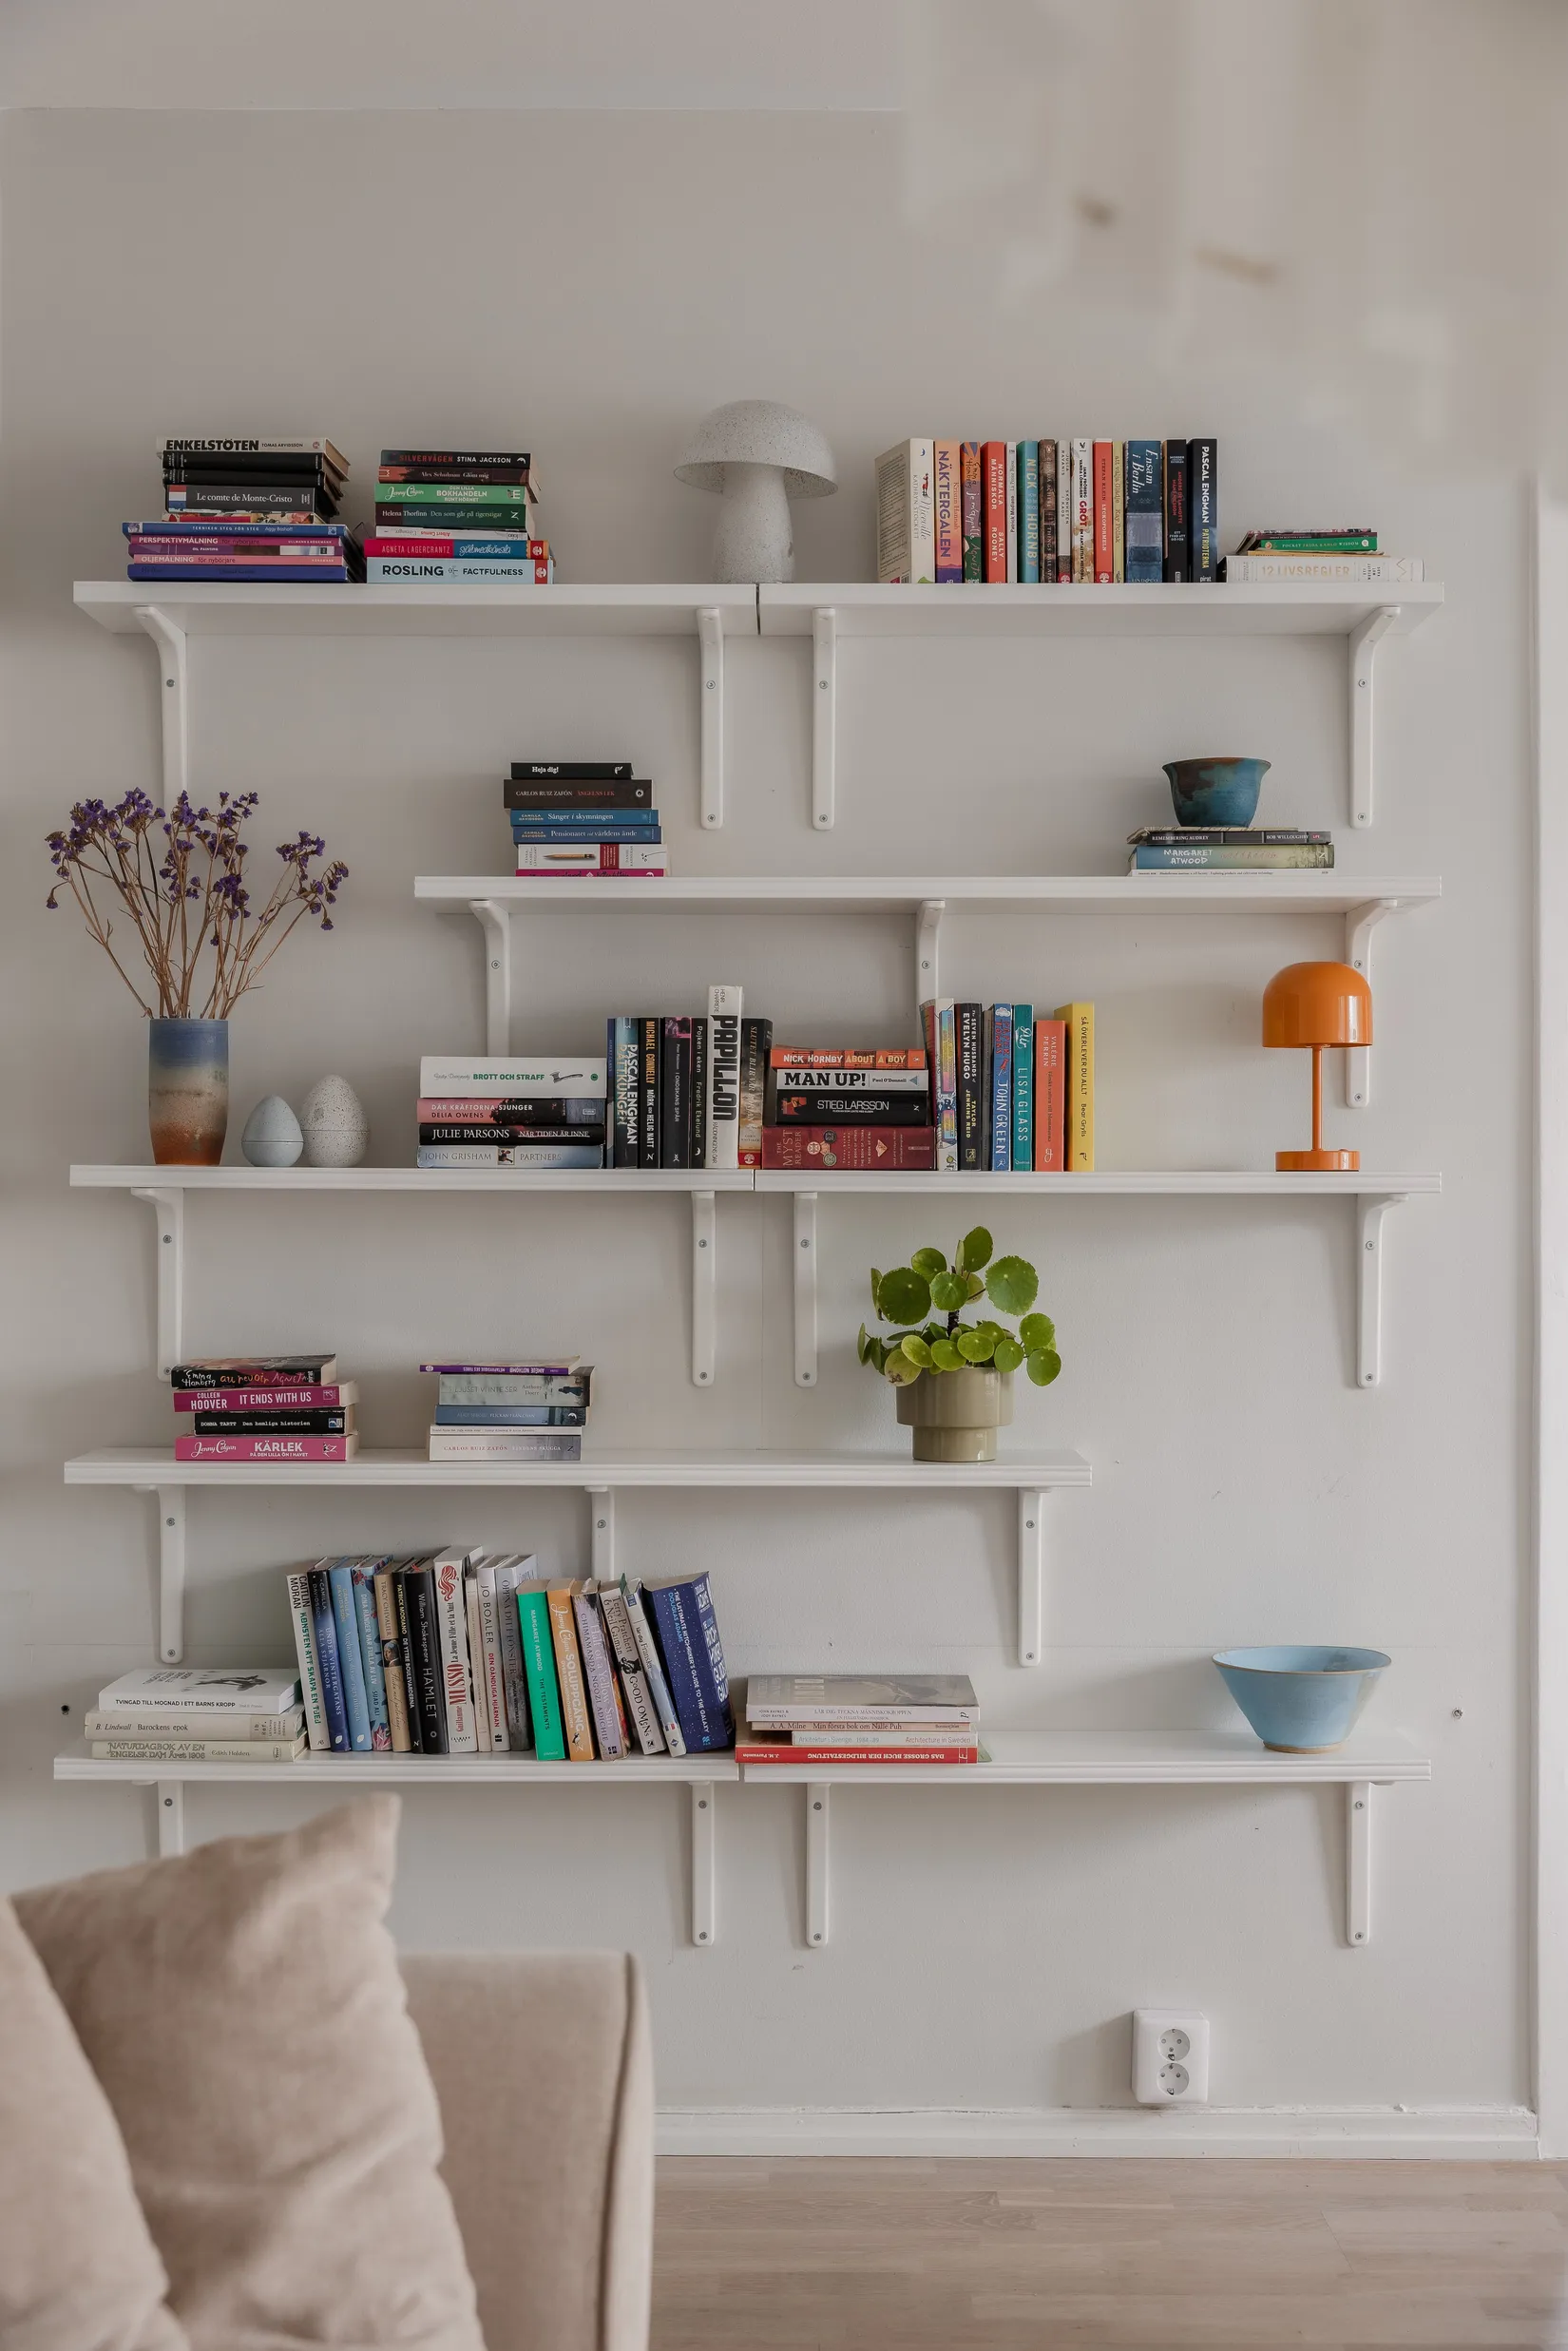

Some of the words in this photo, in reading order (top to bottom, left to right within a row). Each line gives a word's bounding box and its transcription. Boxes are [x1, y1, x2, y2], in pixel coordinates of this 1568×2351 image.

[166, 439, 258, 450] ENKELSTÖTEN
[1027, 459, 1036, 488] NICK
[1132, 462, 1144, 493] Berlin
[1146, 449, 1158, 484] Ensam
[939, 451, 951, 557] NÄKTERGALEN
[1080, 501, 1092, 526] GRÖT
[1027, 514, 1037, 565] HORNBY
[382, 565, 443, 576] ROSLING
[1262, 566, 1272, 575] 12
[1277, 566, 1349, 576] LIVSREGLER
[646, 1021, 655, 1050] MICHAEL
[1081, 1017, 1087, 1025] SÅ
[627, 1044, 638, 1090] PASCAL
[646, 1054, 655, 1083] CONNELLY
[711, 1015, 737, 1120] PAPILLON
[808, 1055, 842, 1063] HORNBY
[1081, 1068, 1086, 1078] DU
[785, 1073, 832, 1085] MAN
[835, 1073, 866, 1086] UP!
[1018, 1068, 1027, 1095] LISA
[817, 1100, 844, 1110] STIEG
[846, 1100, 889, 1110] LARSSON
[997, 1080, 1008, 1111] JOHN
[628, 1092, 638, 1143] ENGMAN
[1019, 1101, 1027, 1140] GLASS
[431, 1130, 461, 1139] JULIE
[464, 1130, 509, 1138] PARSONS
[783, 1131, 793, 1165] MYST
[996, 1115, 1007, 1154] GREEN
[191, 1400, 227, 1409] HOOVER
[239, 1395, 247, 1405] IT
[251, 1394, 272, 1405] ENDS
[276, 1393, 296, 1403] WITH
[300, 1392, 311, 1402] US
[255, 1441, 302, 1452] KÄRLEK
[290, 1577, 301, 1609] MORAN
[298, 1576, 310, 1608] CAITLIN
[418, 1594, 429, 1618] William
[382, 1600, 392, 1636] CHEVALIER
[668, 1593, 678, 1621] DOUGLAS
[674, 1622, 683, 1643] ADAMS
[420, 1621, 430, 1662] Shakespeare
[530, 1610, 539, 1643] MARGARET
[541, 1692, 550, 1730] TESTAMENTS
[581, 1614, 596, 1672] CHIMAMANDA
[591, 1675, 602, 1704] NGOZI
[597, 1707, 607, 1741] ADICHIE
[329, 1657, 341, 1715] VINTERGATANS
[422, 1668, 436, 1718] HAMLET
